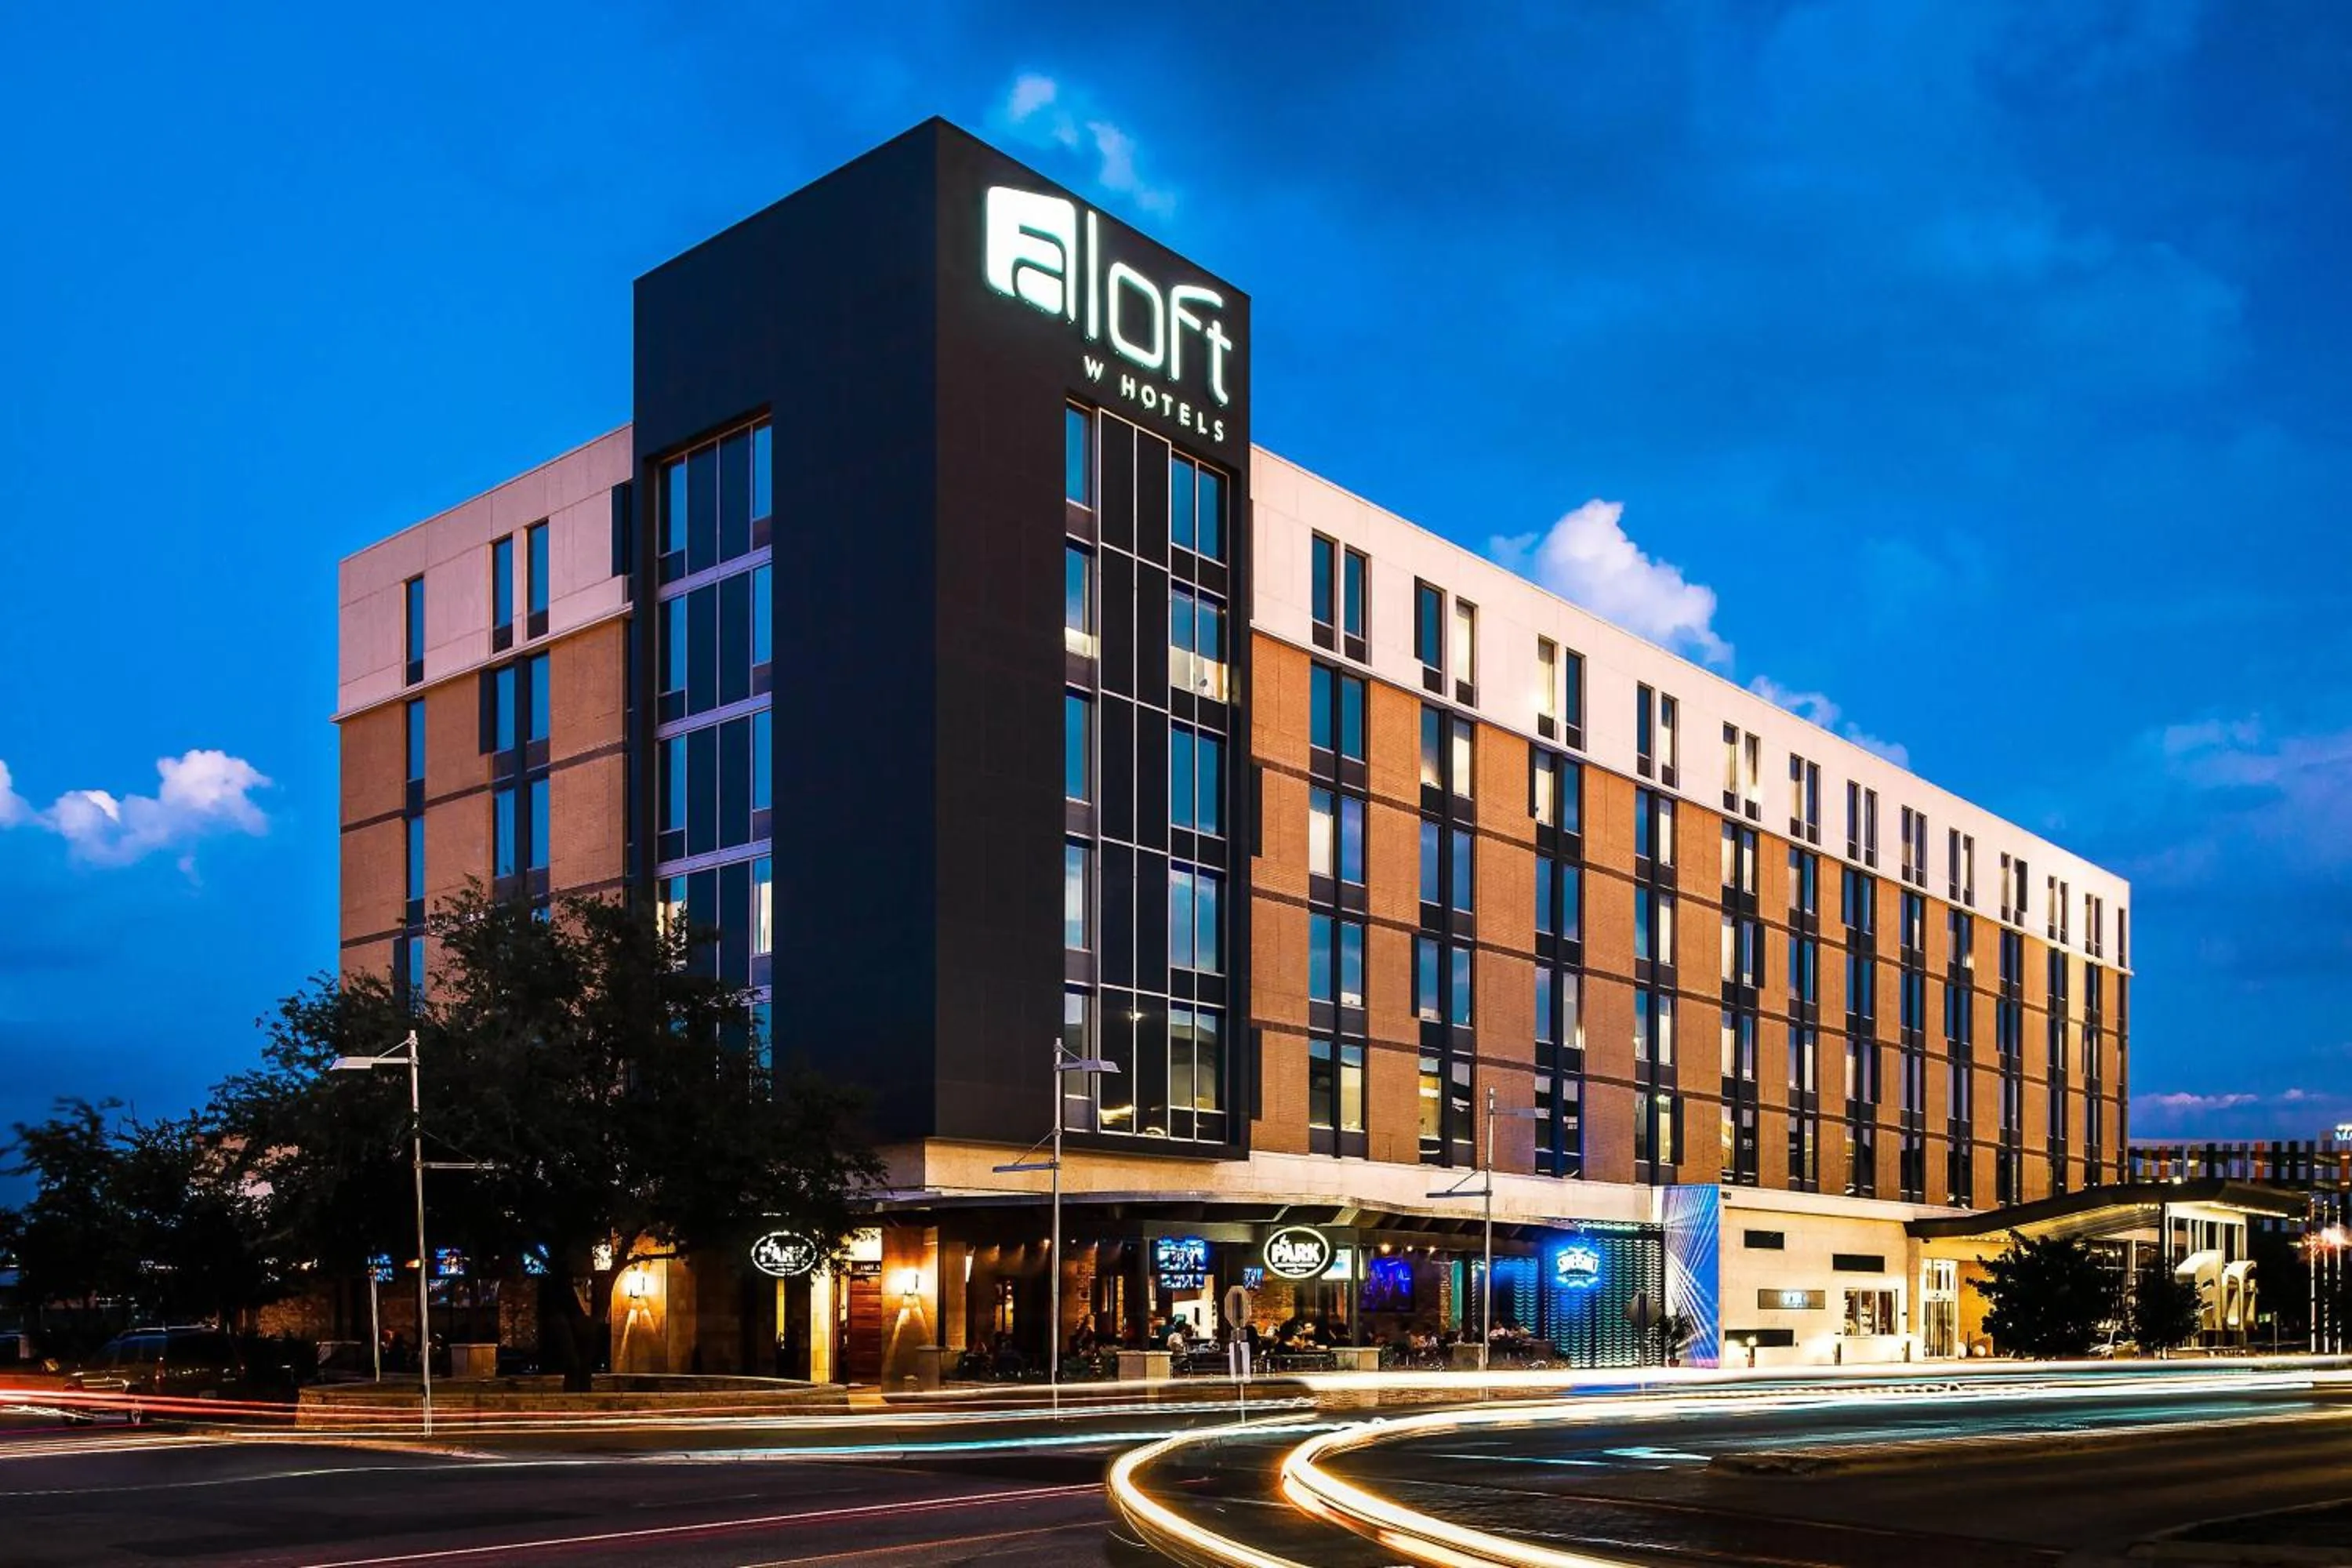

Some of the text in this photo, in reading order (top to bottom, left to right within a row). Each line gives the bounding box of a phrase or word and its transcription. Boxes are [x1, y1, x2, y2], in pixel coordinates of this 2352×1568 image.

[986, 186, 1232, 406] aloft
[1083, 354, 1225, 442] W HOTELS
[1271, 1243, 1321, 1263] PARK
